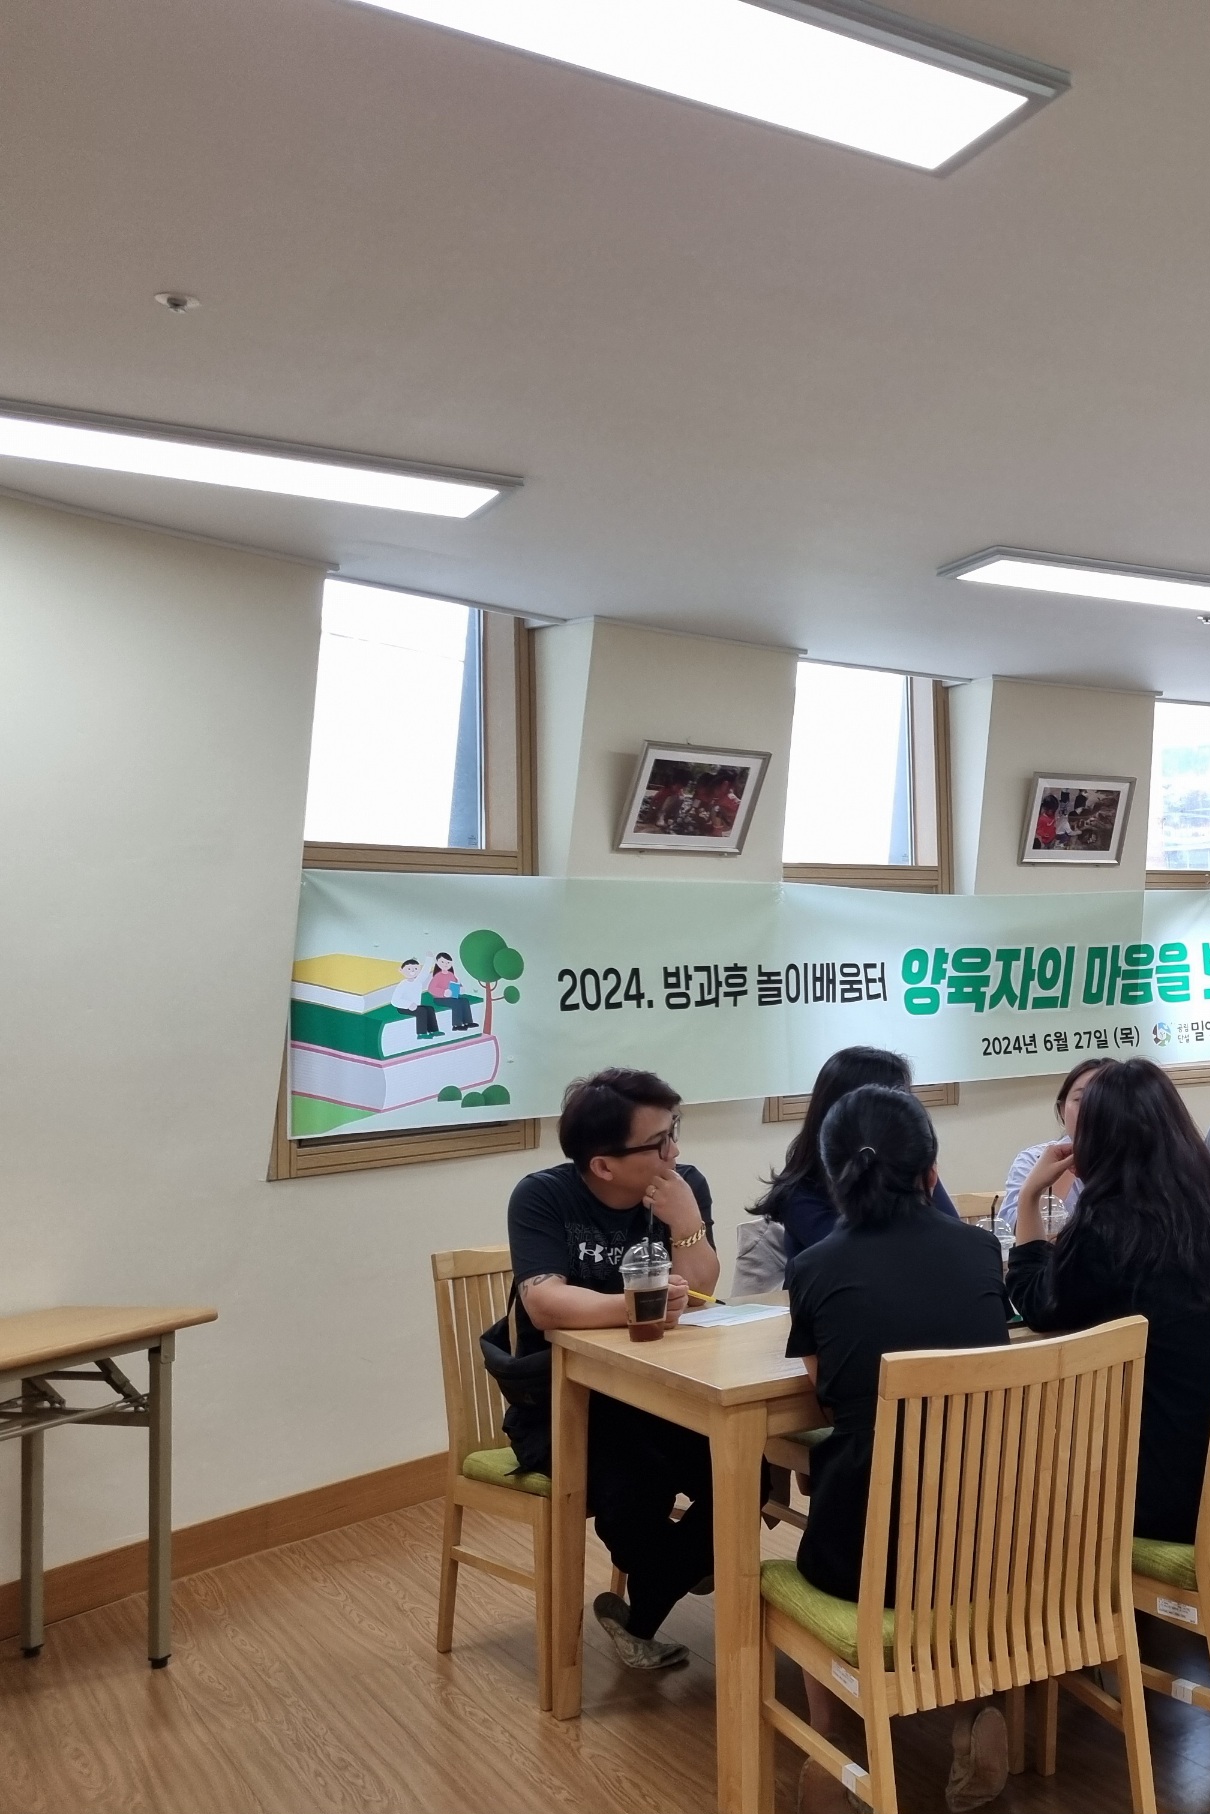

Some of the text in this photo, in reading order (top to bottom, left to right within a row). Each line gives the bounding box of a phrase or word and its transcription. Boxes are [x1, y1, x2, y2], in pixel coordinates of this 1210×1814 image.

[557, 967, 654, 1012] 2024.
[662, 963, 748, 1011] 방과후
[756, 961, 888, 1007] 놀이배움터
[901, 945, 1076, 1016] 양육자의
[1082, 942, 1191, 1007] 마음을
[981, 1025, 1140, 1056] 2024년 6월 27일 (목)
